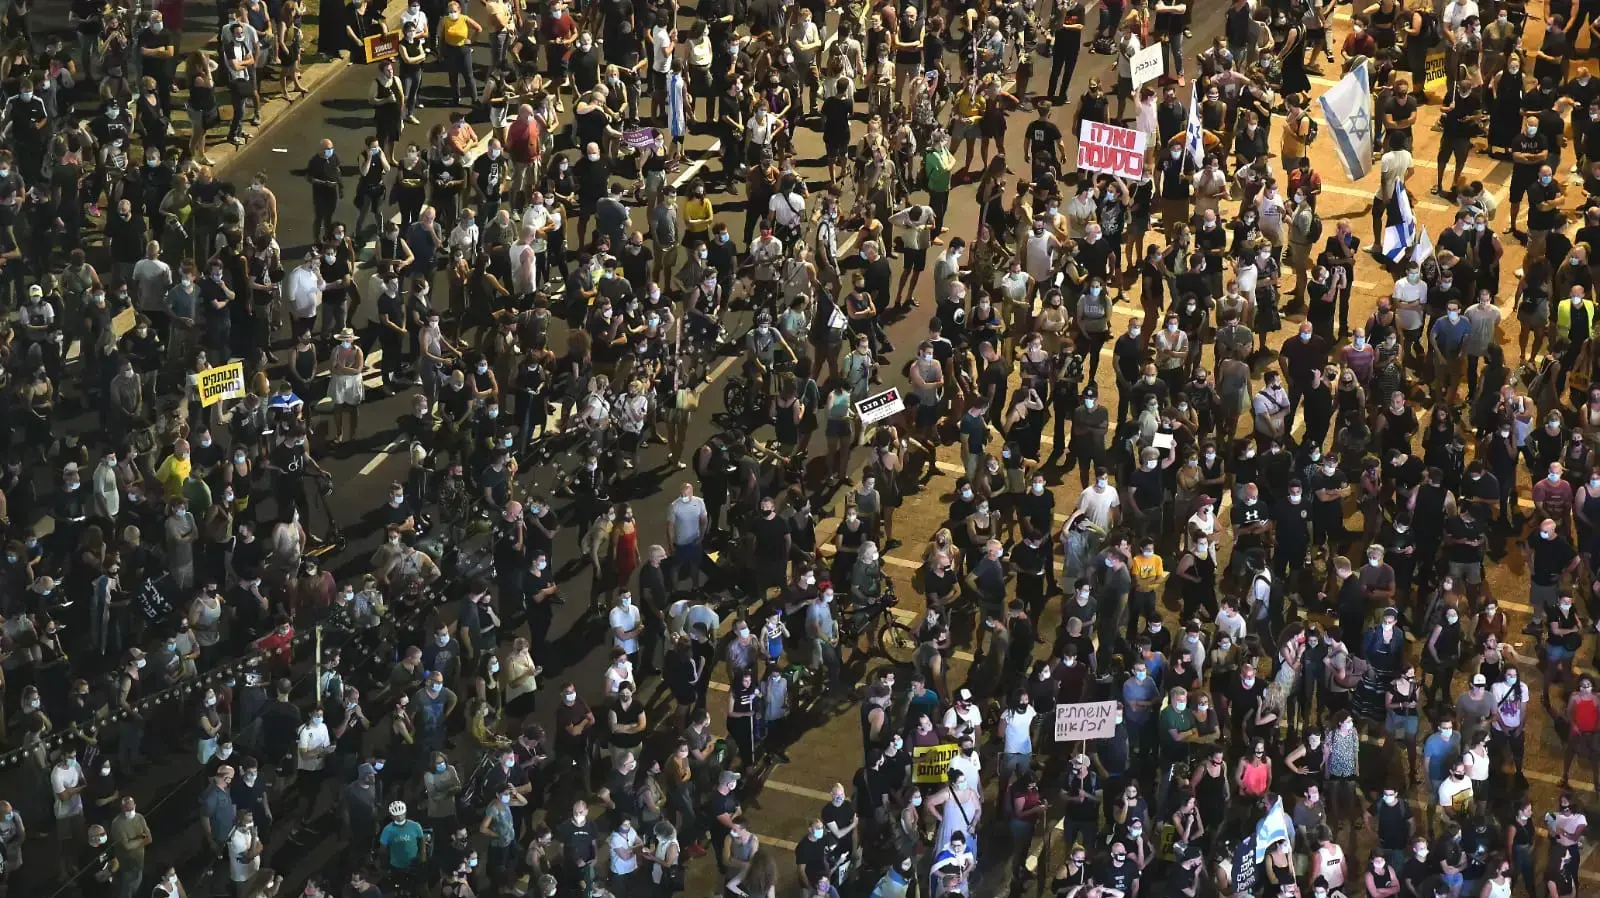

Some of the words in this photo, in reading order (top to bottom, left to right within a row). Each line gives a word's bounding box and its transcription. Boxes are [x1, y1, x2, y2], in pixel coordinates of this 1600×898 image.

[202, 368, 239, 386] מנותקים
[204, 380, 240, 398] נמאסתם
[880, 391, 895, 405] אין
[862, 401, 879, 411] מצב
[1057, 705, 1111, 719] מושחתים
